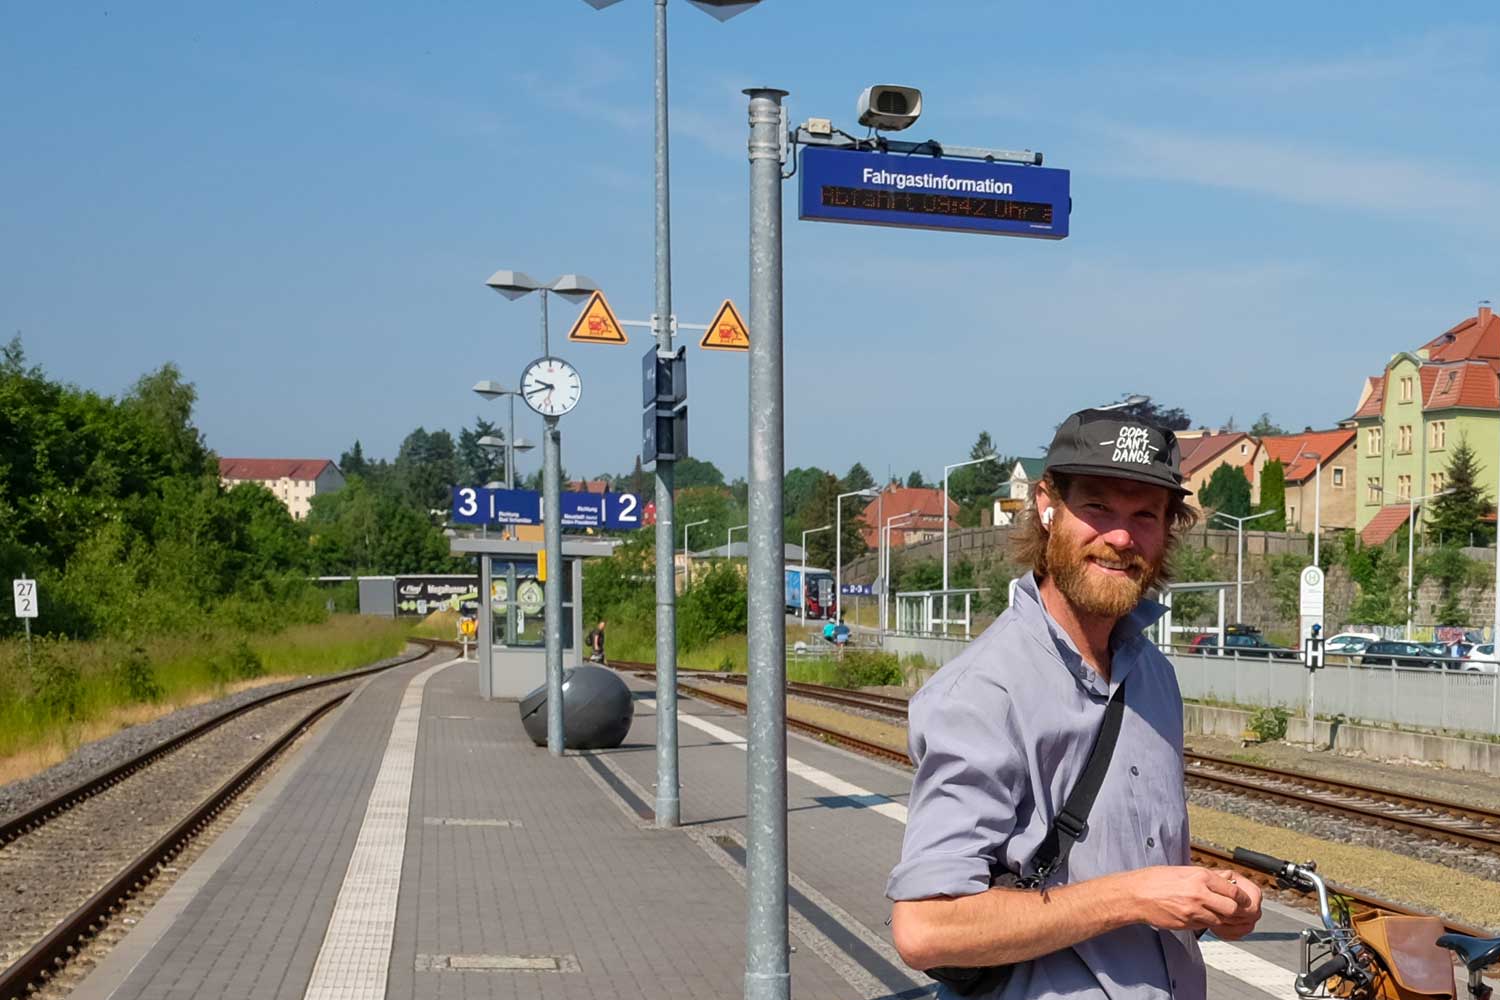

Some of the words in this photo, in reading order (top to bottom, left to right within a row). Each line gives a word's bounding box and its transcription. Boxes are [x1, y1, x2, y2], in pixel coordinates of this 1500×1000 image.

[863, 168, 1013, 194] Fahrgastinformation
[1119, 426, 1149, 440] COPS
[1116, 436, 1149, 451] CAN'T
[458, 487, 478, 516] 3
[618, 493, 638, 522] 2
[17, 583, 33, 596] 27
[22, 598, 31, 612] 2
